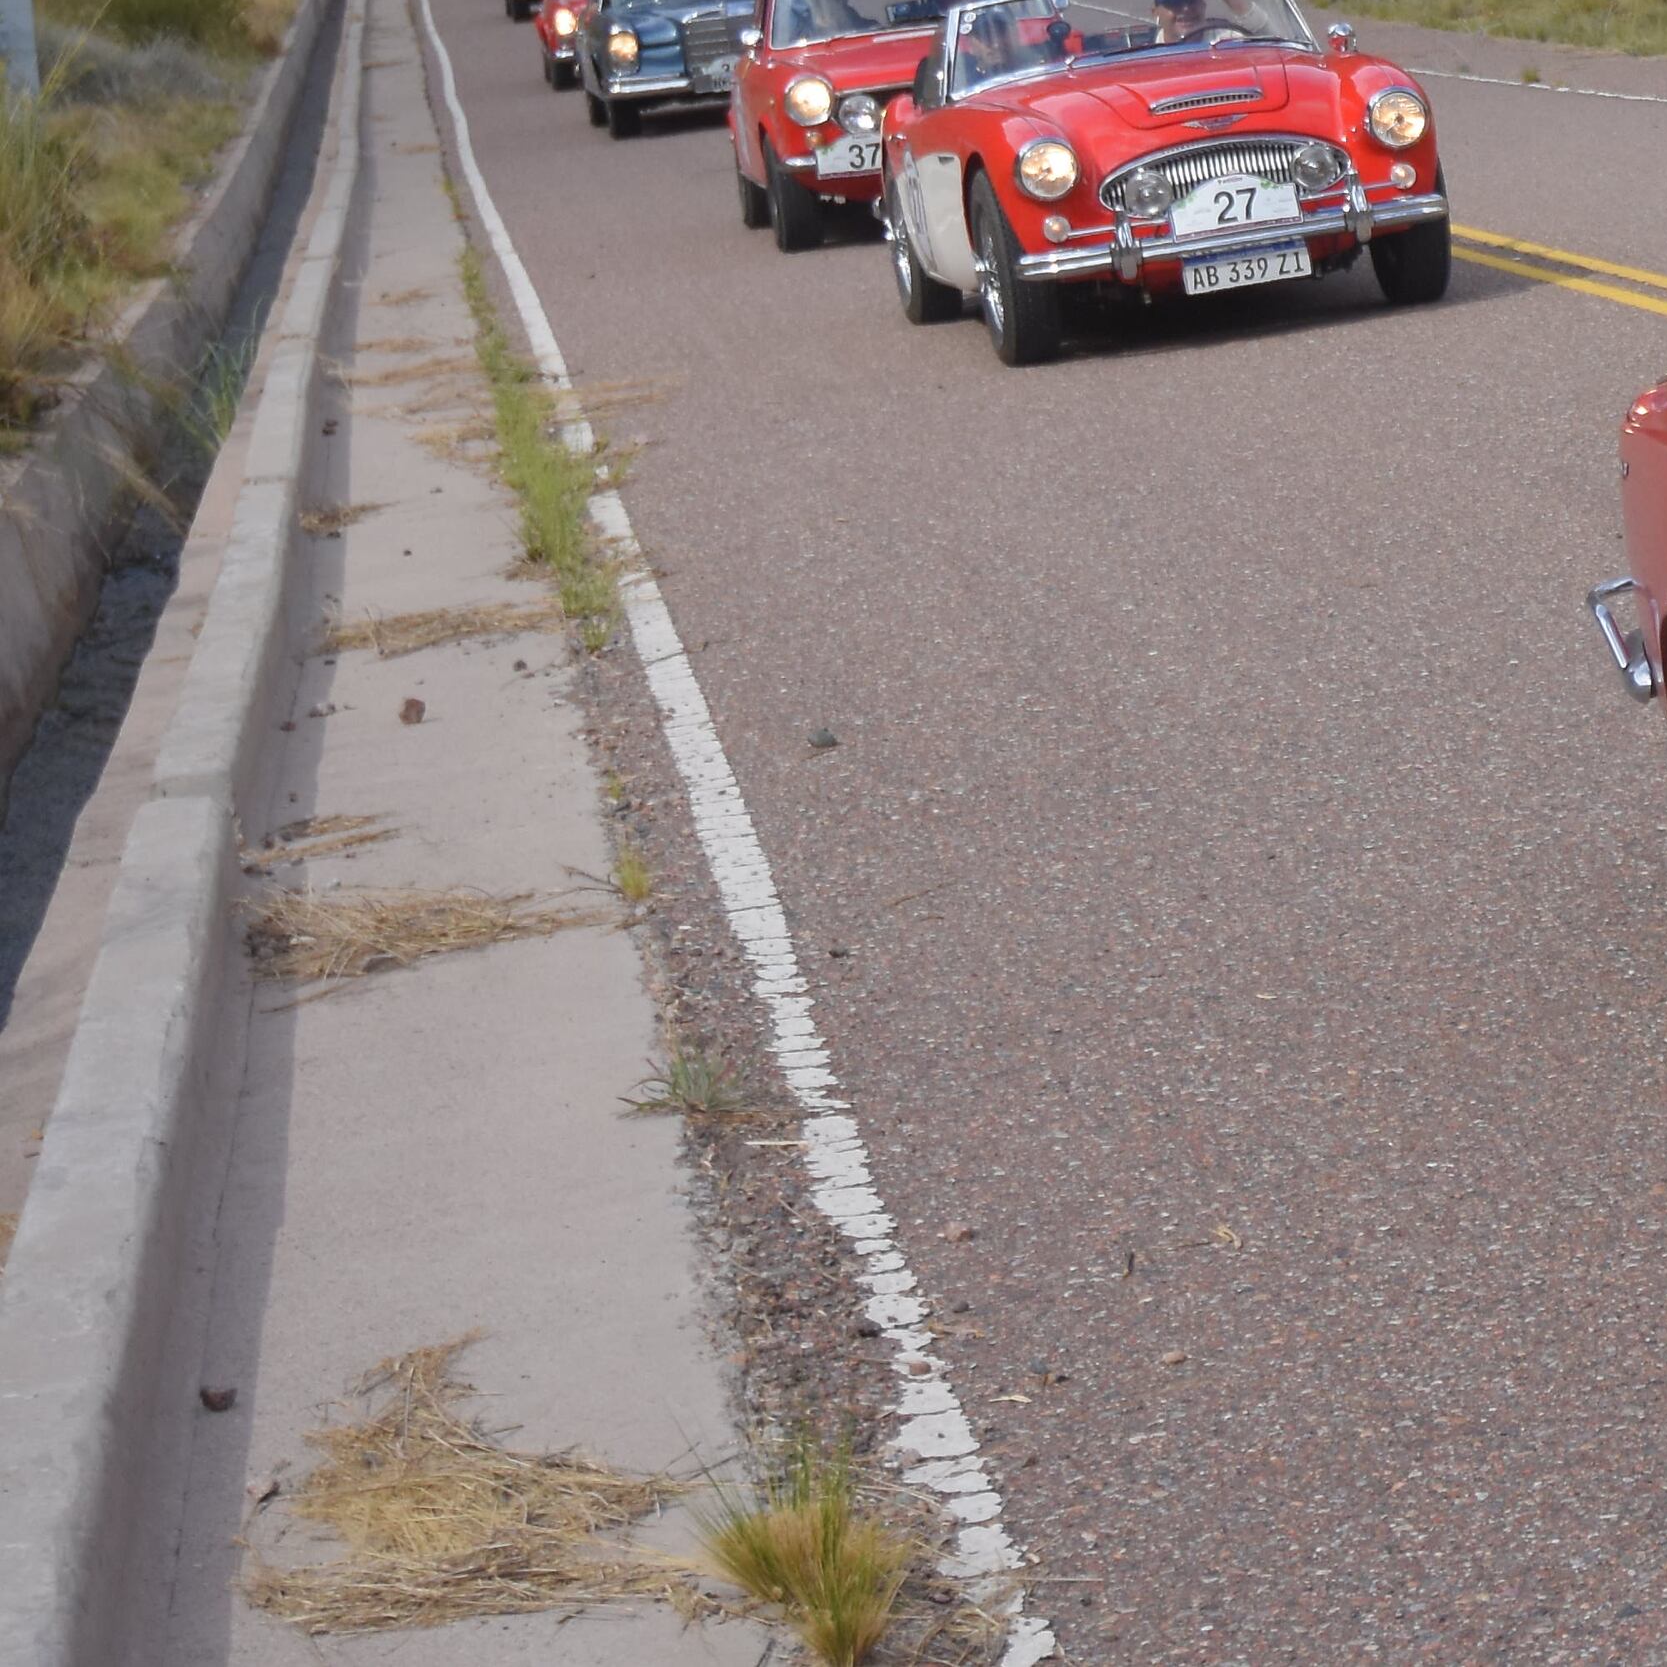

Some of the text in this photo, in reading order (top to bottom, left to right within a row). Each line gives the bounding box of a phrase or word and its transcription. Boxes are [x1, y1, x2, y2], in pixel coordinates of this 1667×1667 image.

[848, 142, 881, 169] 37
[1213, 187, 1257, 225] 27
[1192, 251, 1305, 290] AB 339 ZI
